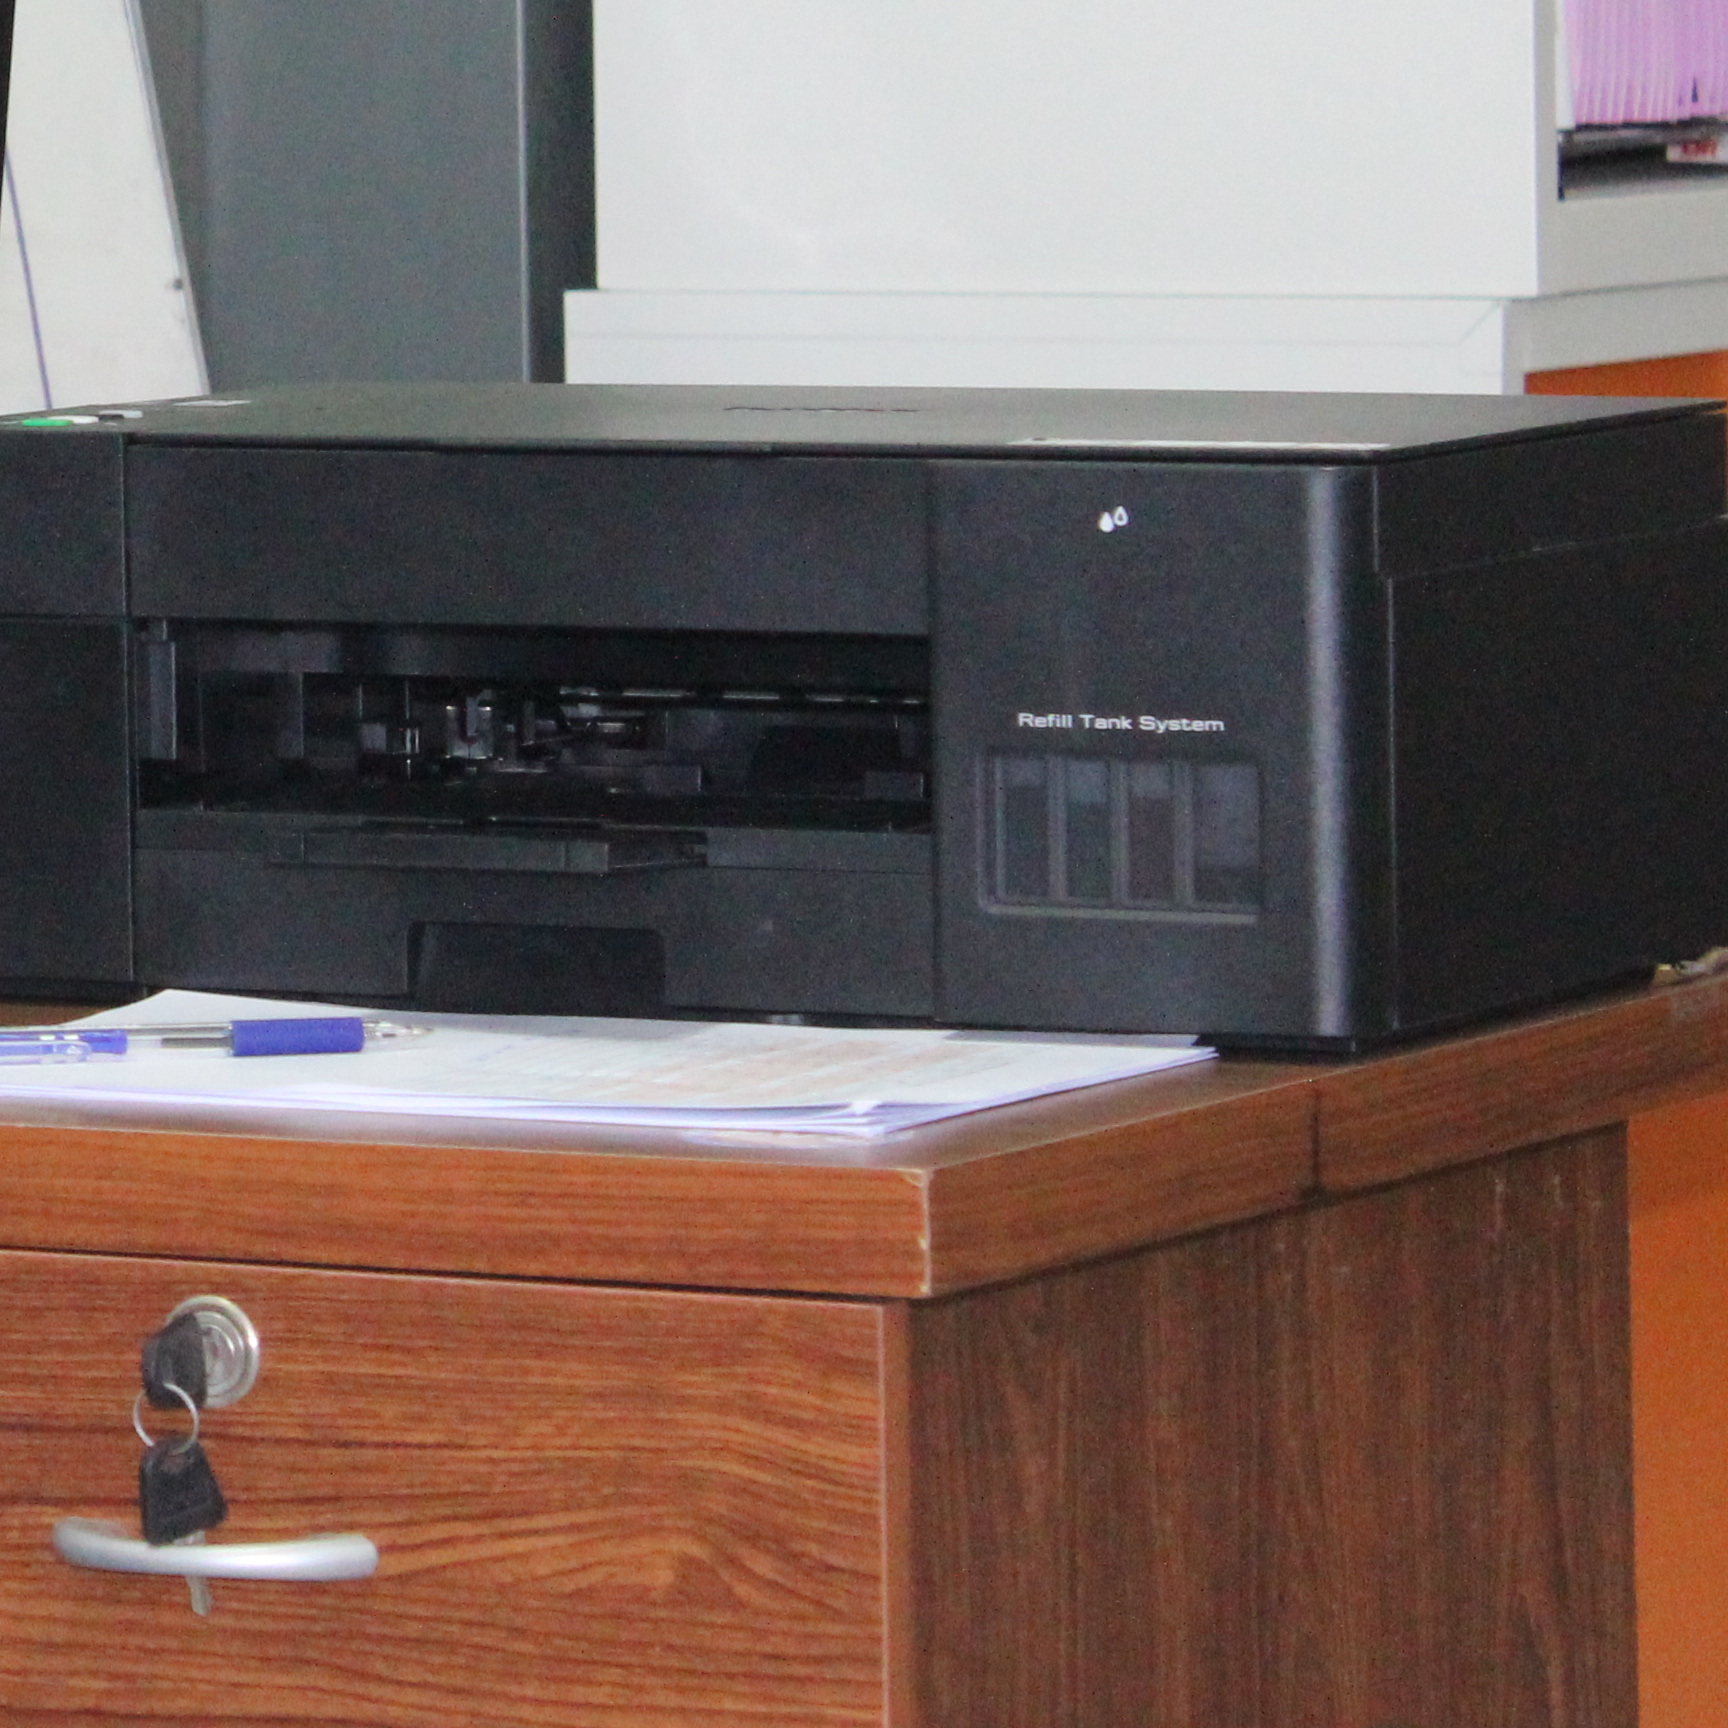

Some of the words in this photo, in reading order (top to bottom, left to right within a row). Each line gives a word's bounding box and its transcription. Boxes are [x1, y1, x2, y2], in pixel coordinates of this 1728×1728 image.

[1018, 712, 1074, 731] Refill
[1079, 713, 1134, 732] Tank
[1139, 714, 1226, 736] System
